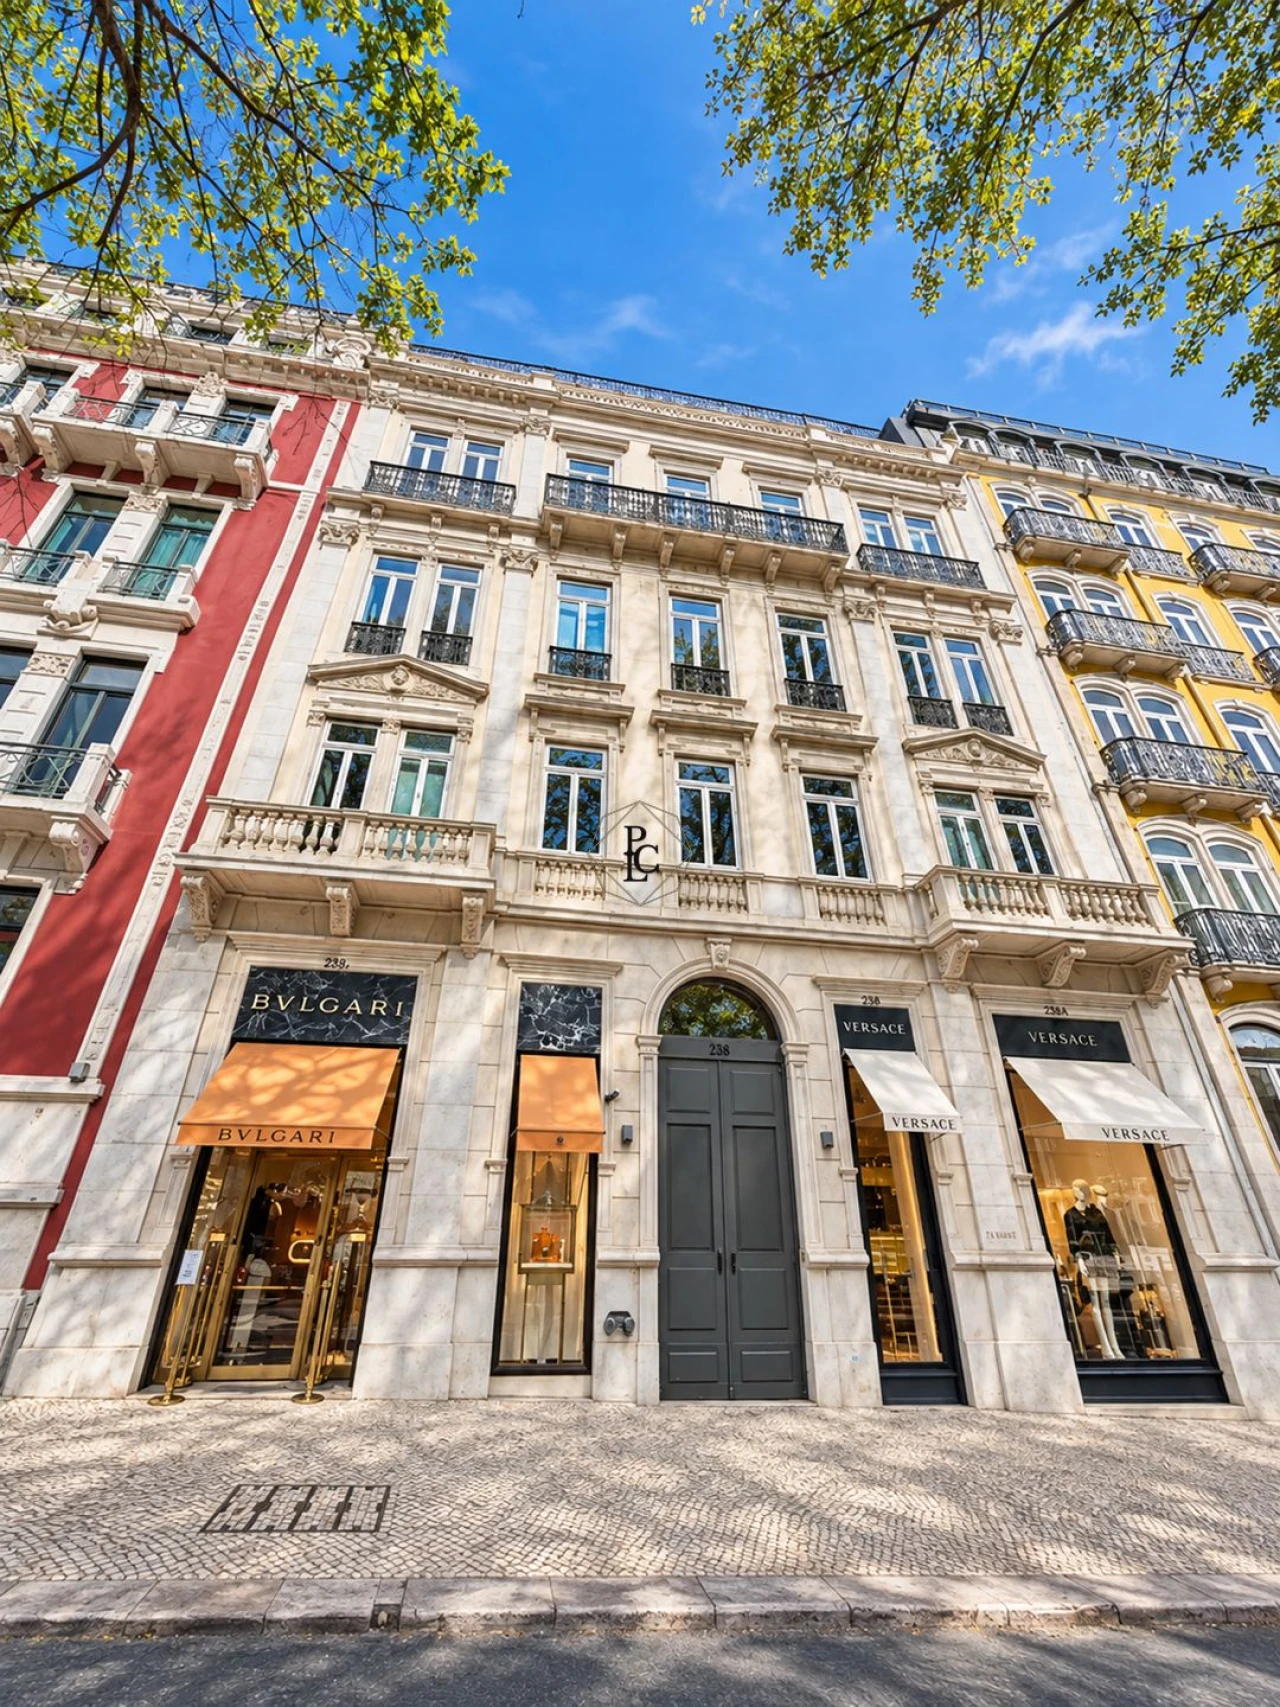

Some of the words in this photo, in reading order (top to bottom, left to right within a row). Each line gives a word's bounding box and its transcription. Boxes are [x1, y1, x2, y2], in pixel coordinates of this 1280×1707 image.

[250, 993, 404, 1018] BVLGARI
[861, 995, 881, 1006] 238
[1043, 1005, 1070, 1017] 238A
[843, 1021, 906, 1035] VERSACE
[1028, 1031, 1098, 1047] VERSACE
[709, 1043, 730, 1057] 238
[891, 1116, 957, 1131] VERSACE
[217, 1127, 336, 1144] BVLGARI
[1101, 1126, 1171, 1142] VERSACE
